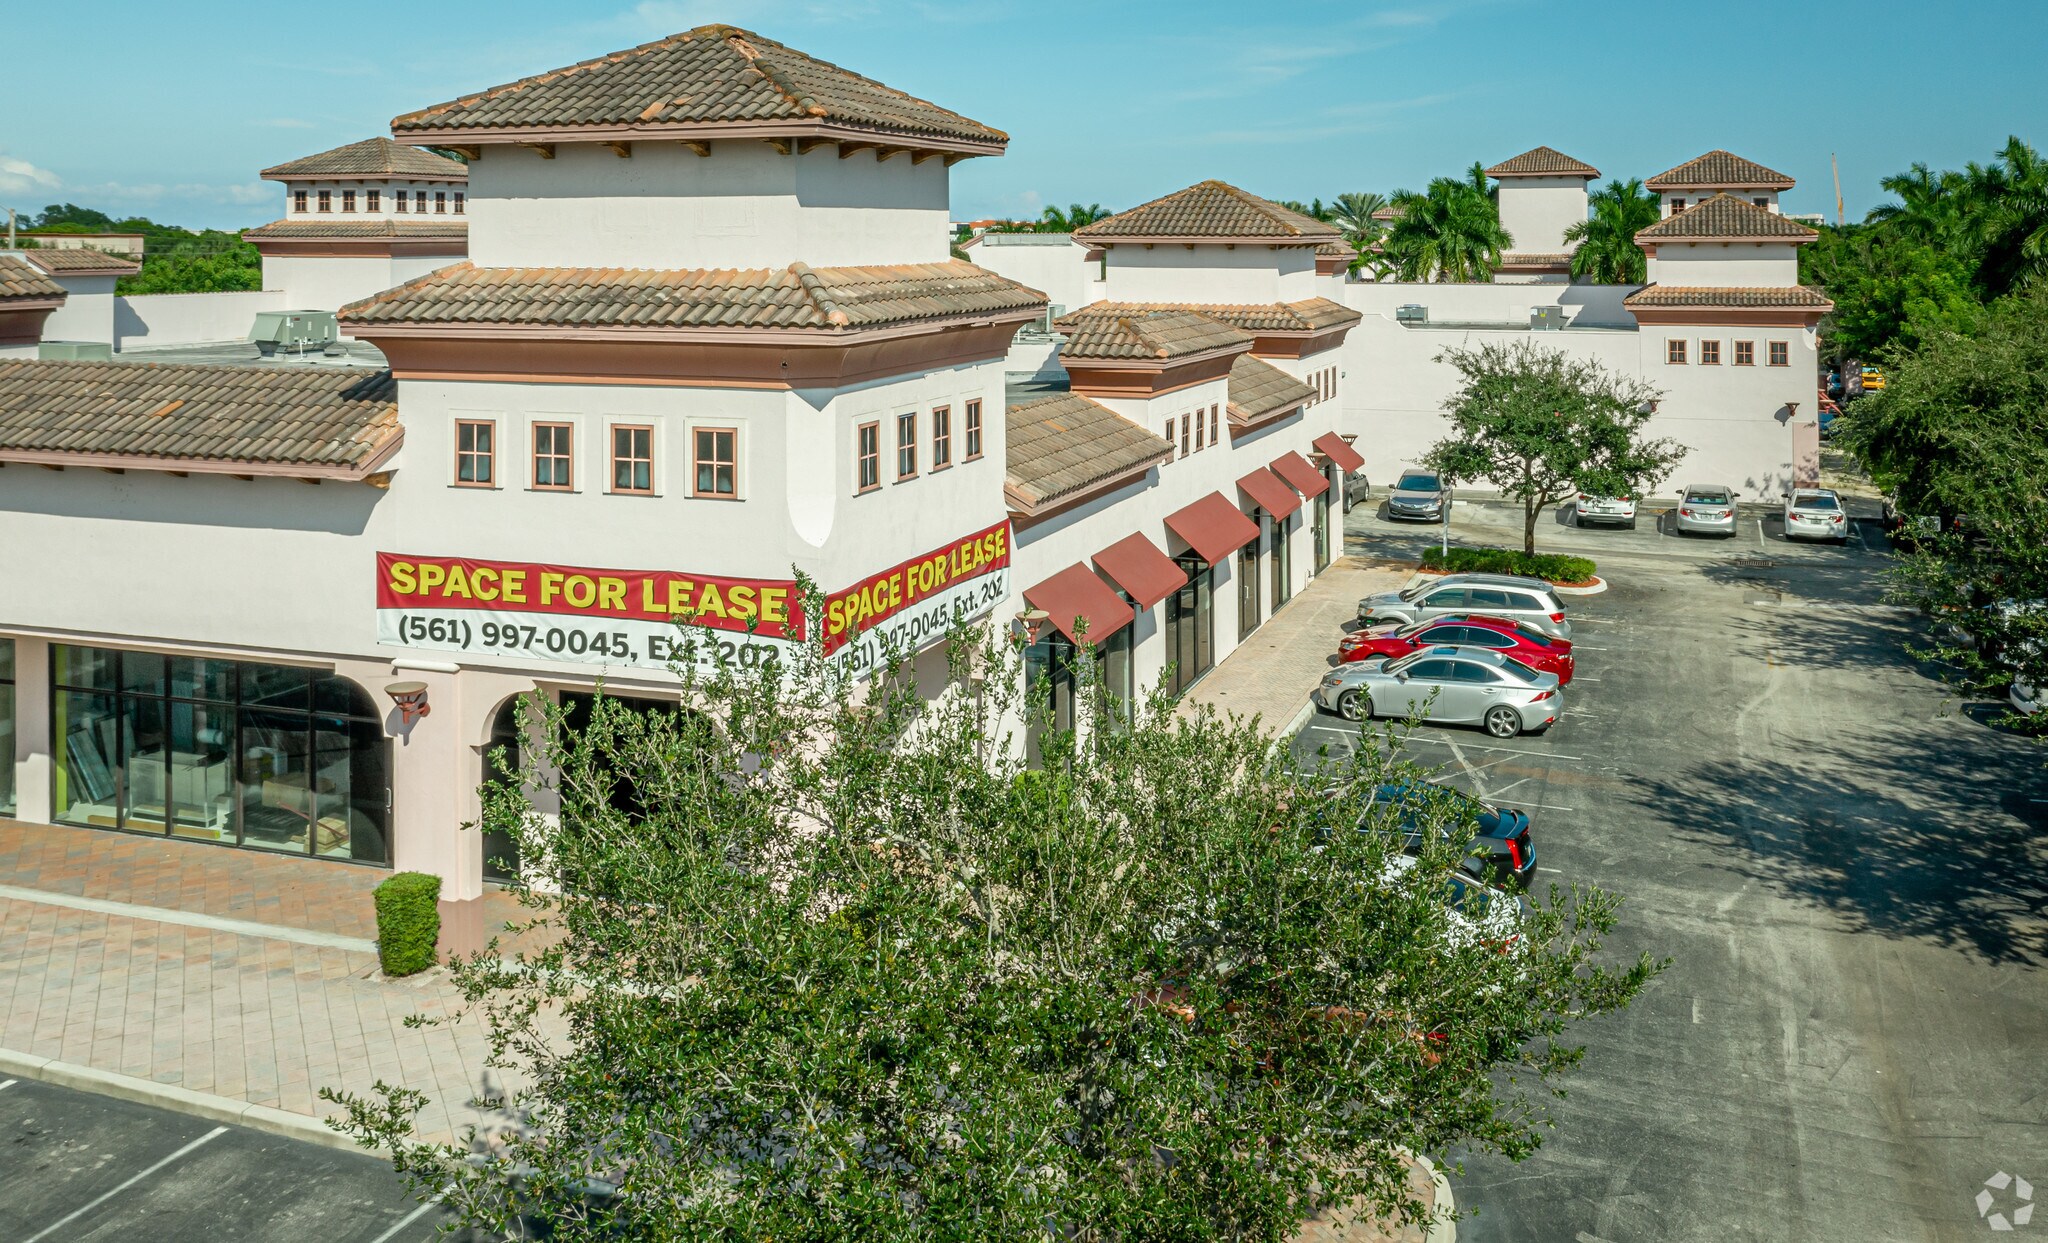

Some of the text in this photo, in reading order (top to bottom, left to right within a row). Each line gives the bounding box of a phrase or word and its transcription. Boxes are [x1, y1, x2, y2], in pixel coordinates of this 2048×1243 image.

[389, 561, 789, 623] SPACE FOR LEASE
[828, 527, 1006, 635] SPACE FOR LEASE
[879, 603, 950, 658] 997-0045,
[954, 591, 979, 618] Ext.
[981, 575, 1003, 604] 202
[399, 614, 472, 650] (561)
[481, 621, 639, 663] 997-0045,
[717, 641, 780, 671] 202
